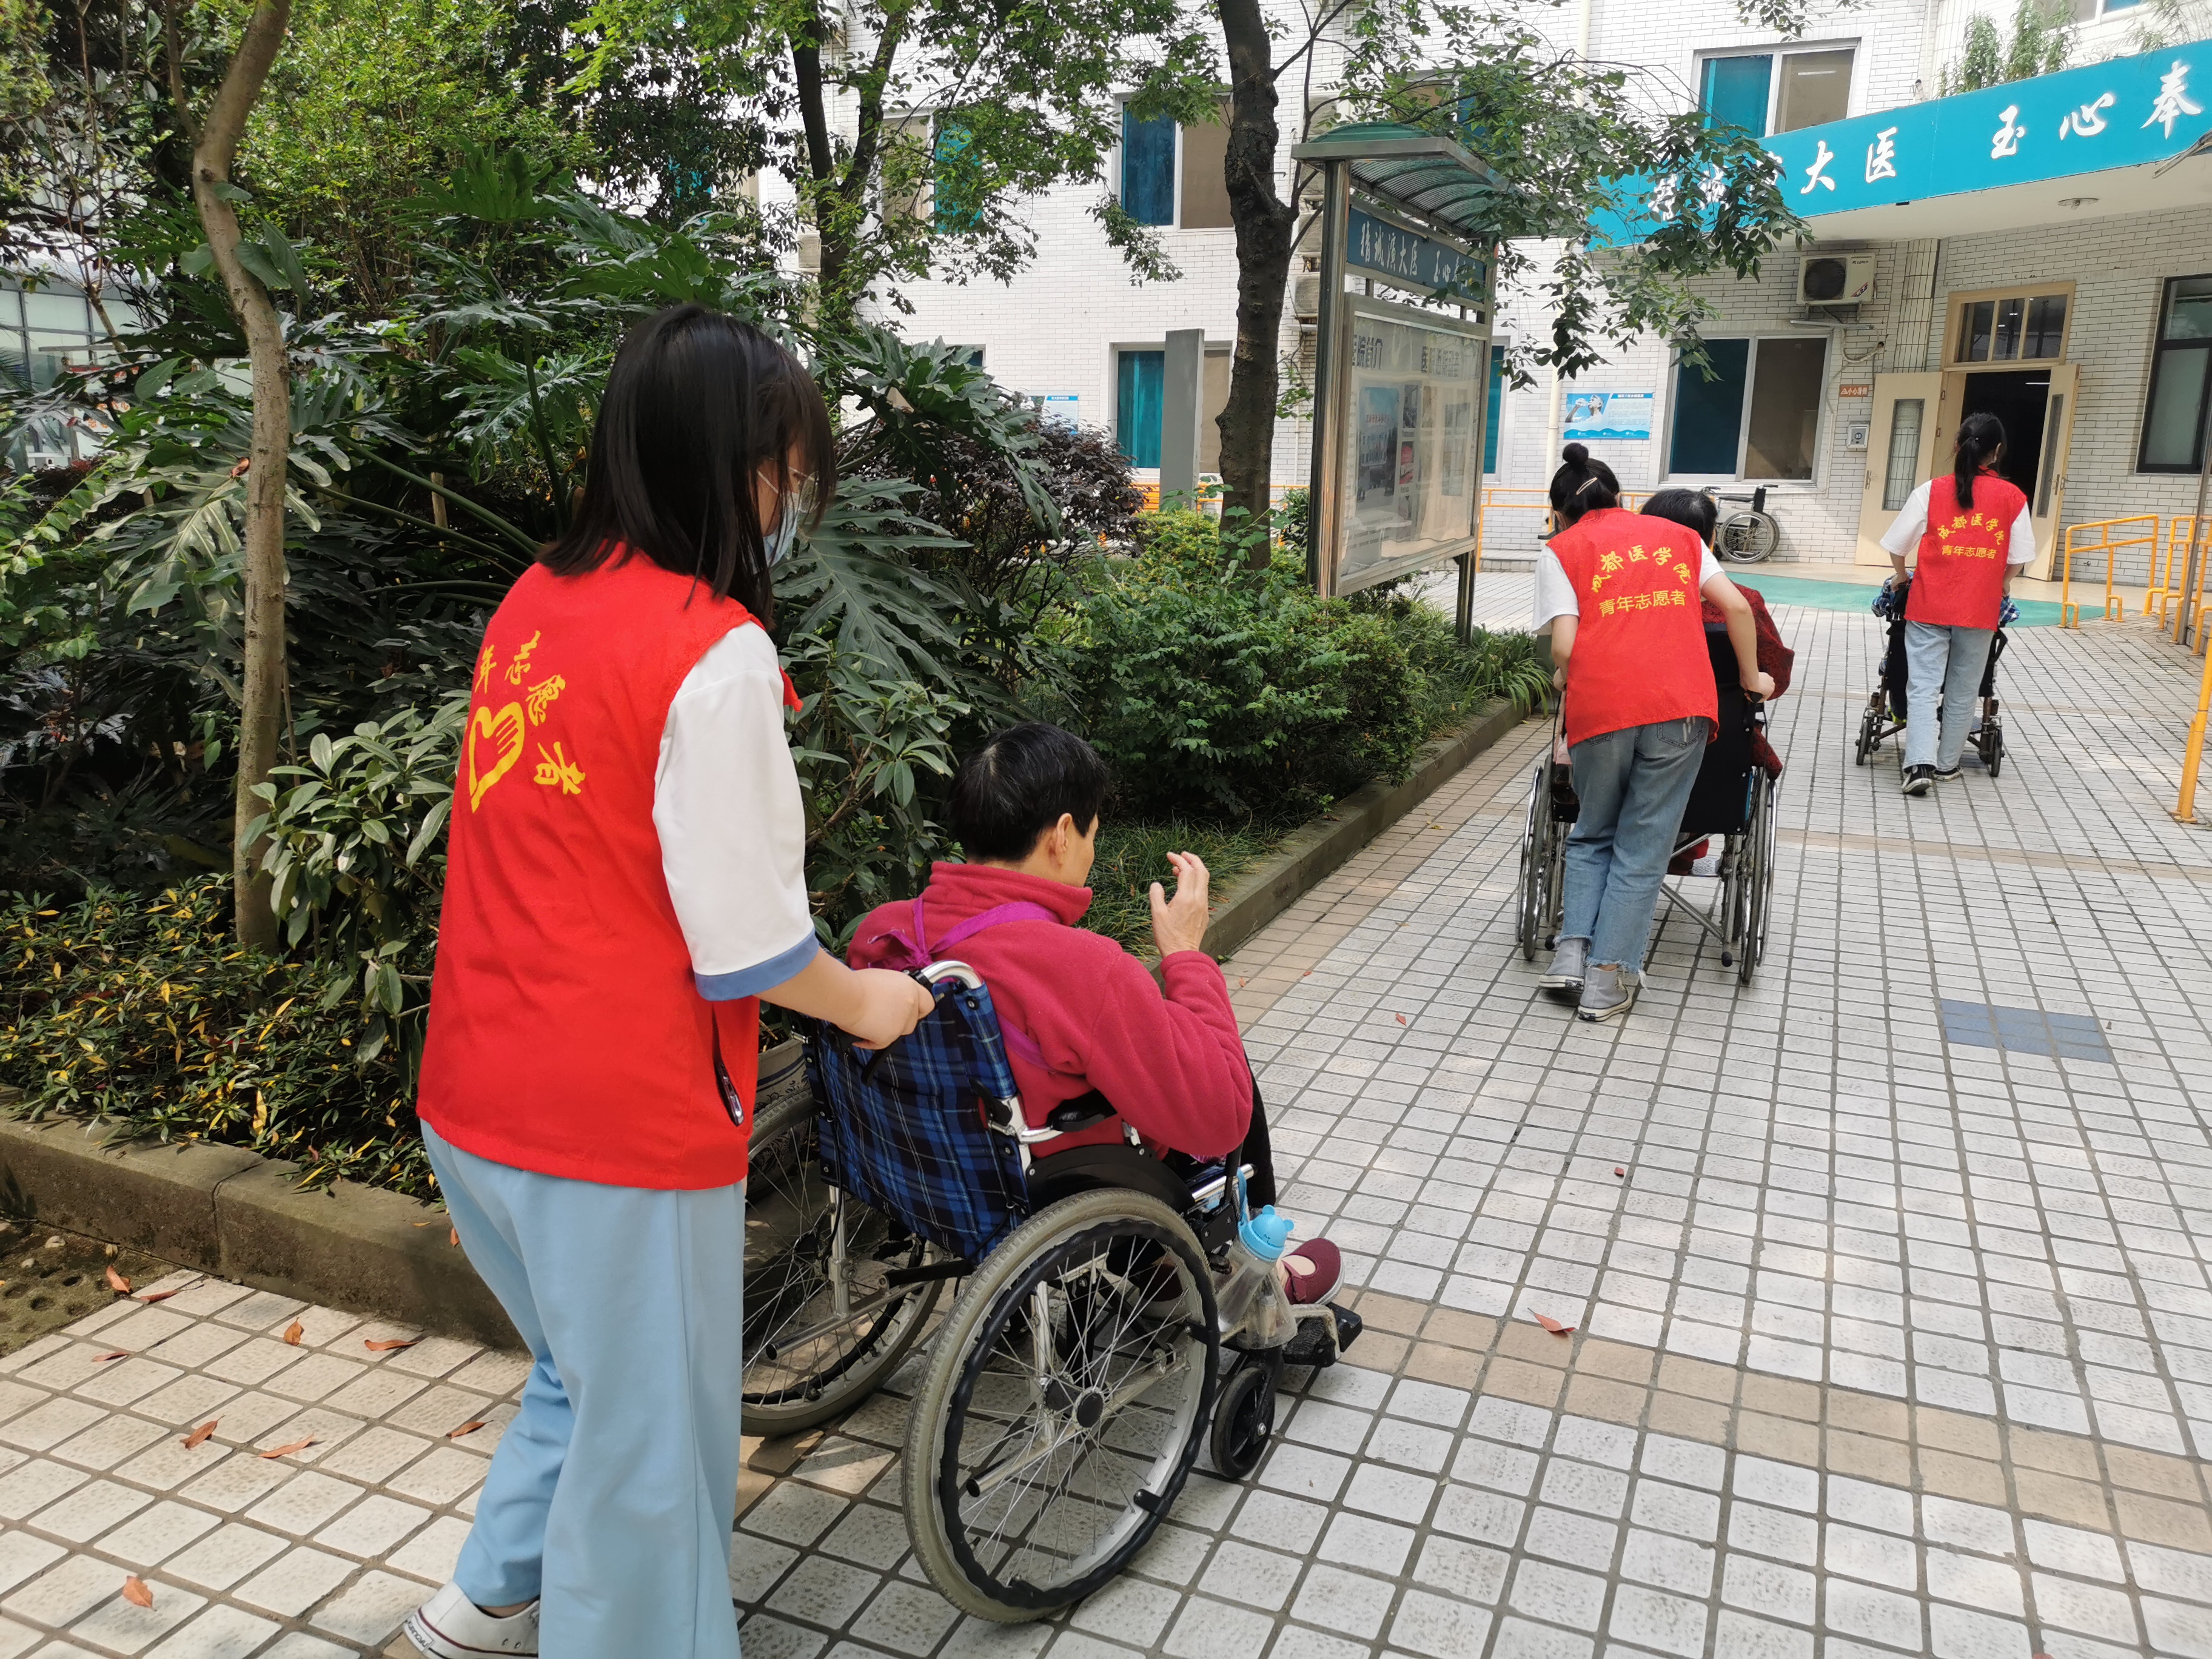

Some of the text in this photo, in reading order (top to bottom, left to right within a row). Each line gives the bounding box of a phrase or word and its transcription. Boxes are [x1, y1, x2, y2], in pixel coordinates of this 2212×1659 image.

[1942, 545, 1997, 560] 青年志愿者
[1590, 544, 1692, 594] 成都医学院
[1599, 589, 1686, 617] 青年志愿者
